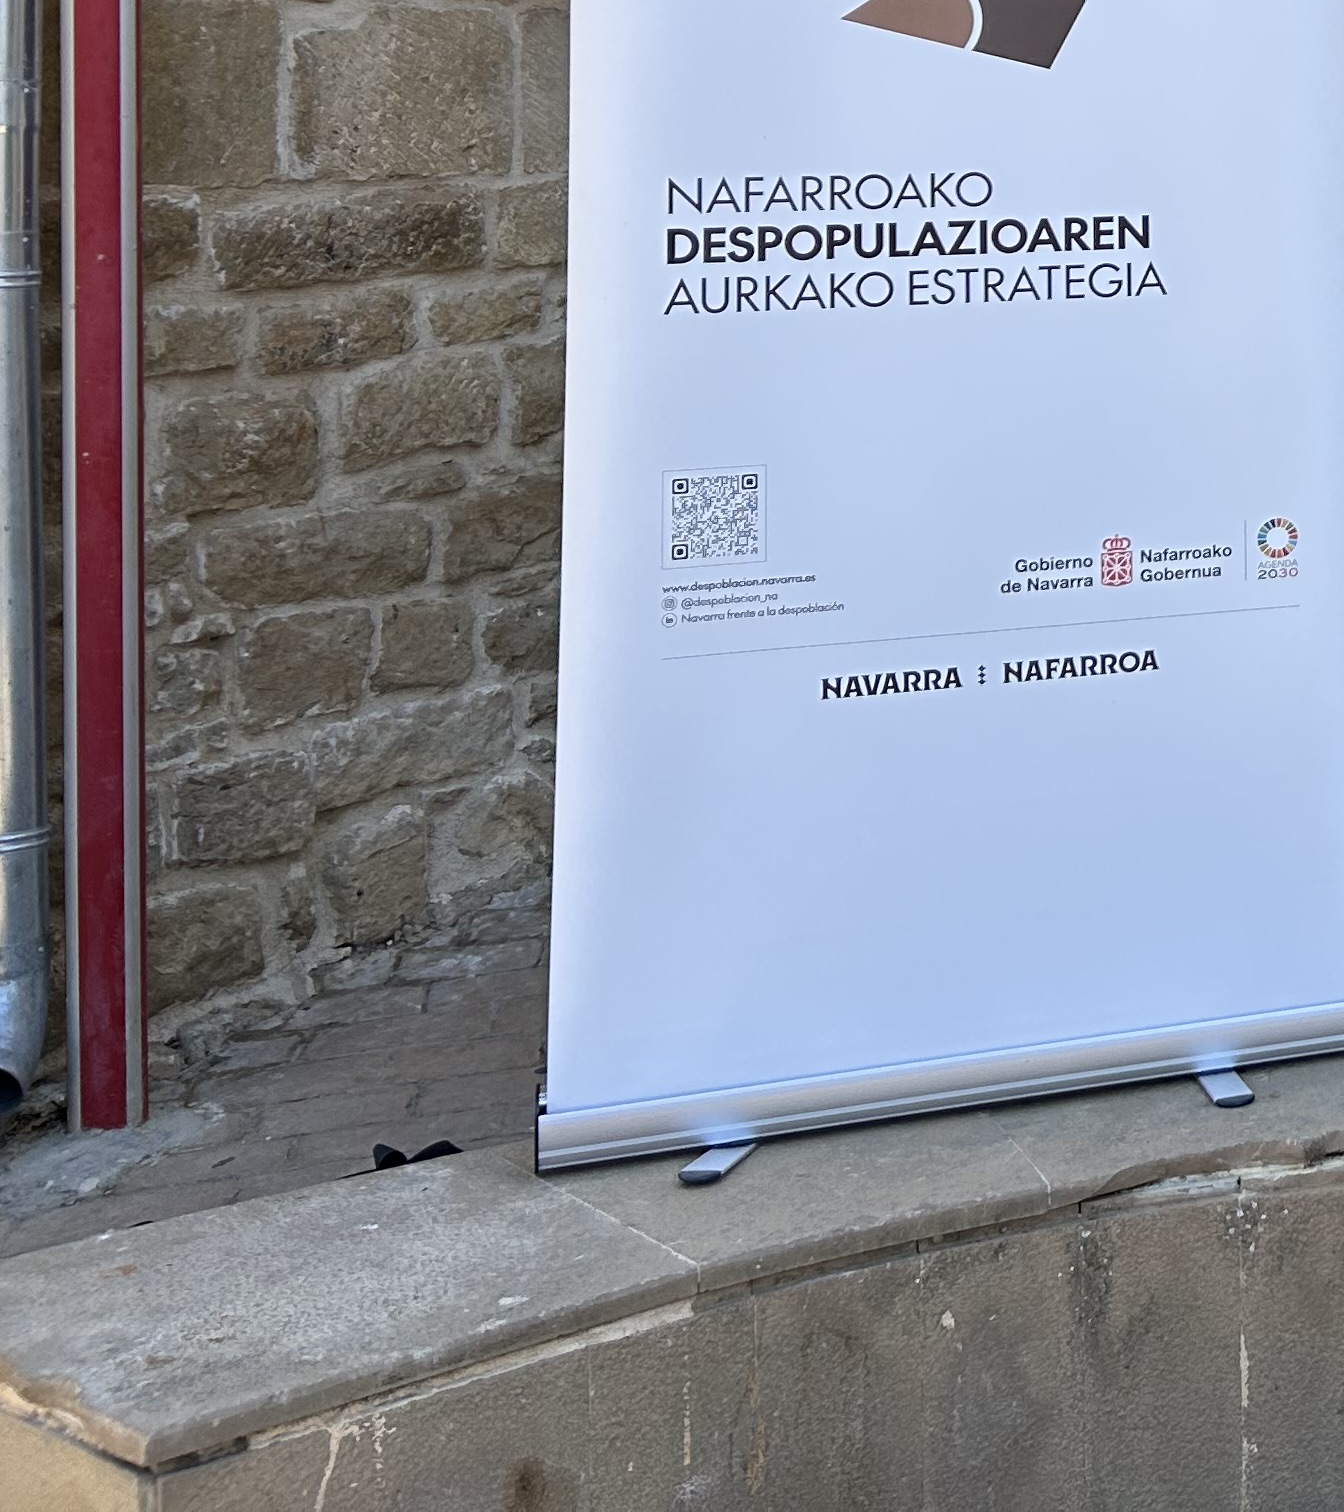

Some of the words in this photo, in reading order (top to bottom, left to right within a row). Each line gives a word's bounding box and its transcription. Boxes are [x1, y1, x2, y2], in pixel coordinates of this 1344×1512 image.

[668, 171, 993, 215] NAFARROAKO
[666, 214, 1151, 265] DESPOPULAZIOAREN
[664, 270, 894, 315] AURKAKO
[908, 261, 1168, 306] ESTRATEGIA
[1140, 544, 1233, 563] Nafarroako
[1015, 555, 1094, 573] Gobierno
[1258, 558, 1299, 569] AGENDA
[1140, 565, 1222, 583] Gobernua
[1257, 568, 1299, 579] 2030
[662, 574, 816, 593] www.despoblacion.navarra.es
[1000, 579, 1022, 594] de
[1027, 575, 1094, 592] Navarra
[681, 613, 725, 624] Navarra
[727, 609, 756, 620] frente
[766, 606, 777, 616] la
[778, 601, 845, 617] despoblación
[820, 667, 964, 700] NAVARRA
[1002, 649, 1160, 684] NAFARROA
